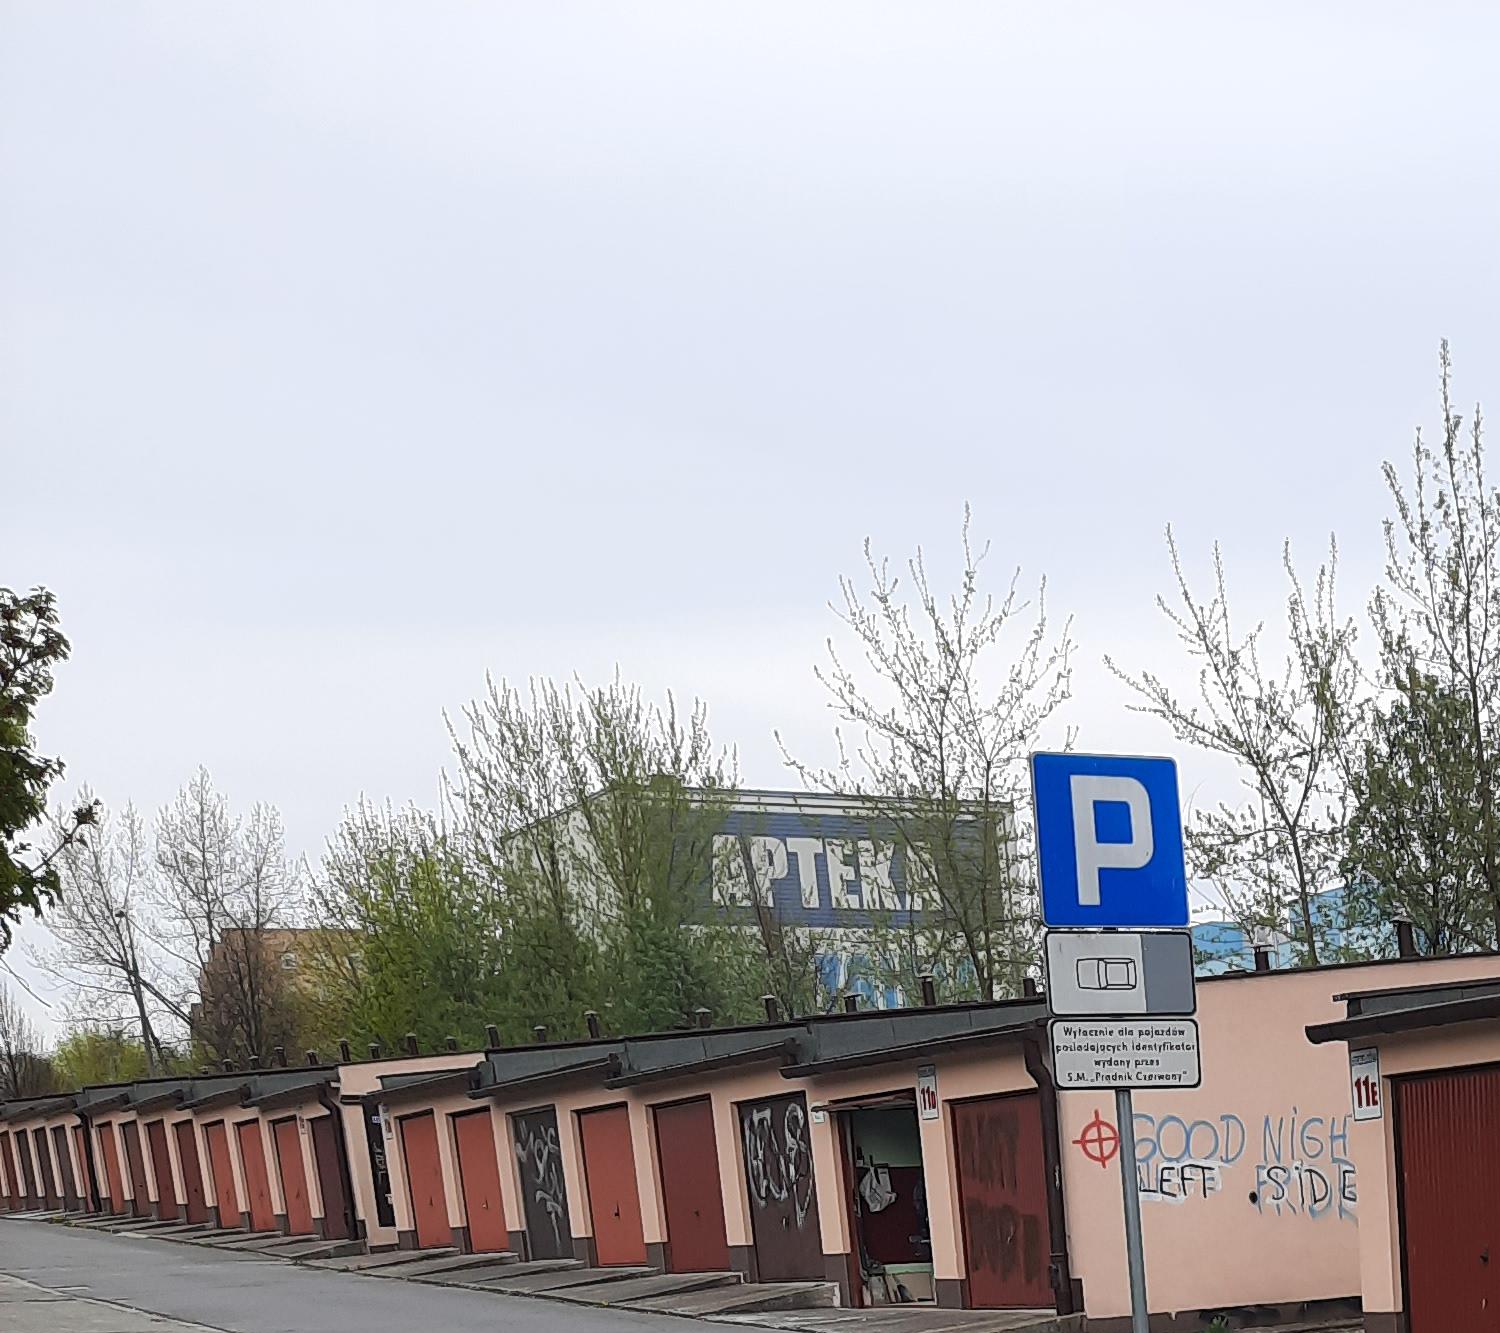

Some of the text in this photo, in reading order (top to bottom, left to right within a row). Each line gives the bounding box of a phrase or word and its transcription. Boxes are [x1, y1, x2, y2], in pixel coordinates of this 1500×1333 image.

[1069, 775, 1154, 906] P
[712, 835, 946, 911] APTEKA
[1118, 1026, 1134, 1037] dla
[1138, 1026, 1186, 1039] pojazdów
[1094, 1057, 1131, 1069] wydany
[1354, 1075, 1379, 1109] 11E
[1132, 1106, 1353, 1164] GOOD NIGH
[1137, 1163, 1216, 1199] LEFT
